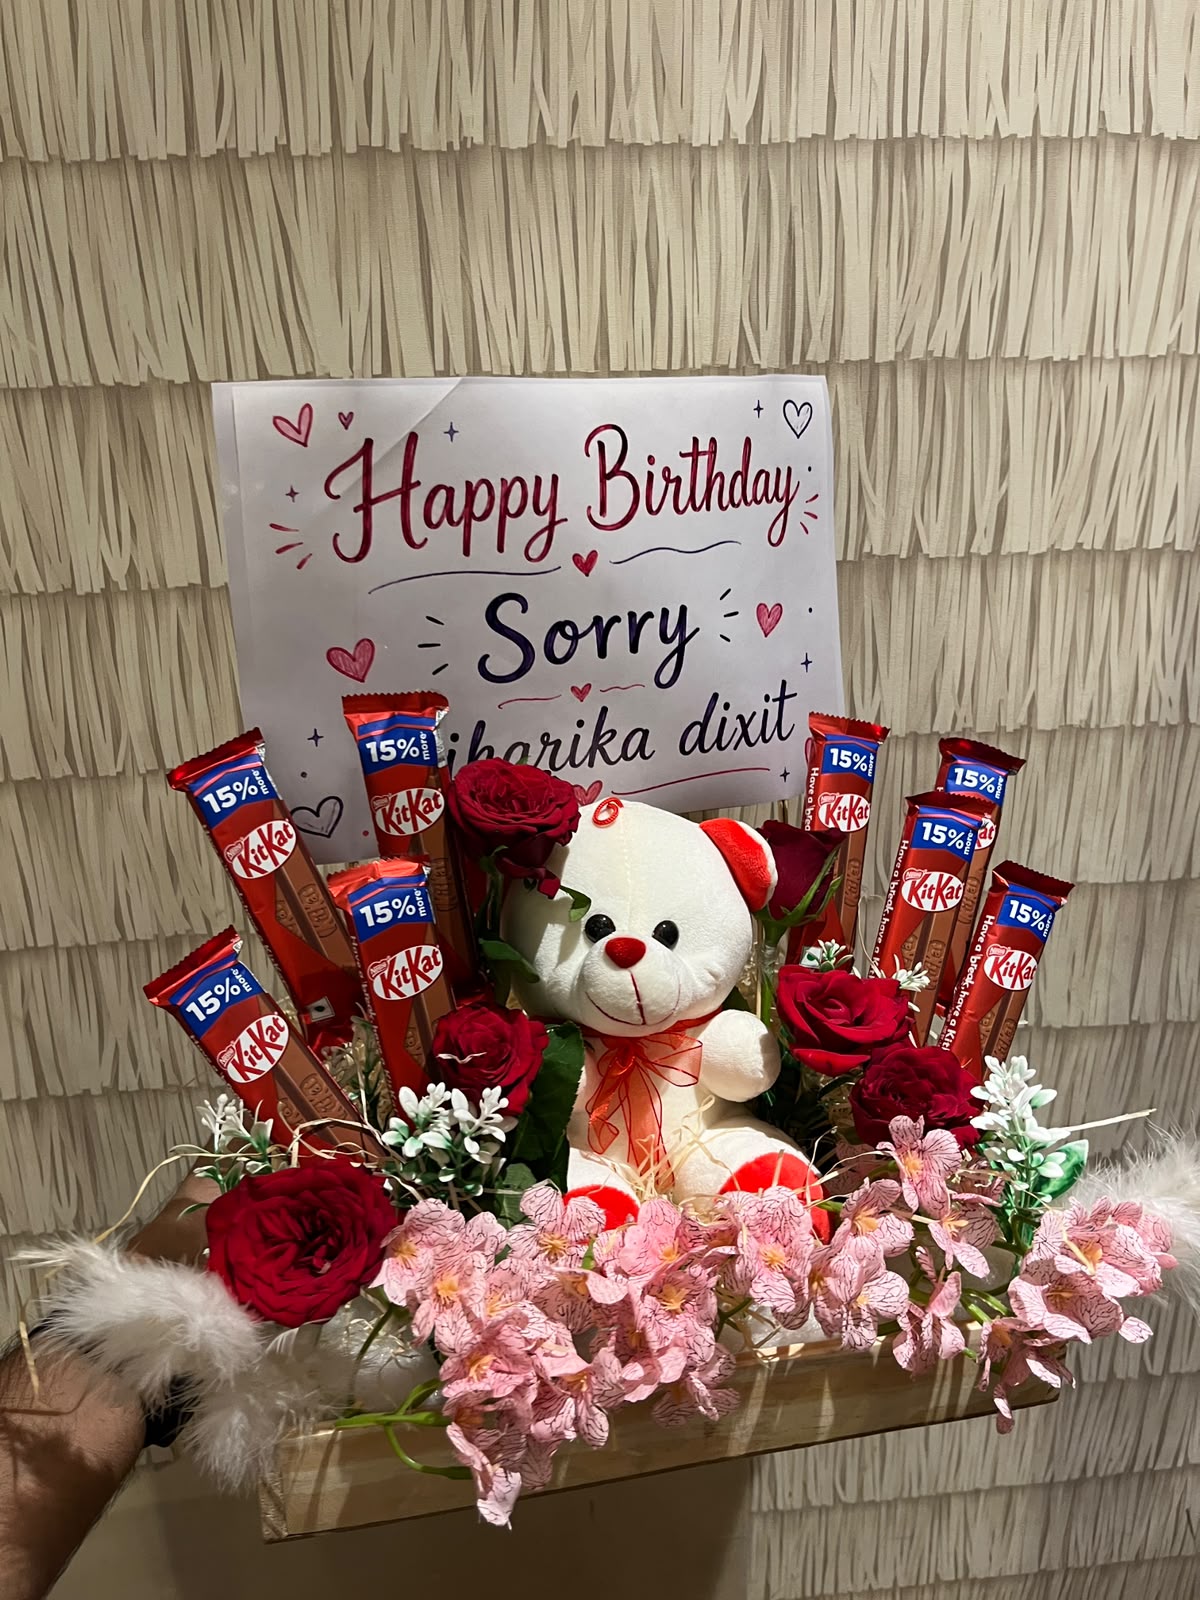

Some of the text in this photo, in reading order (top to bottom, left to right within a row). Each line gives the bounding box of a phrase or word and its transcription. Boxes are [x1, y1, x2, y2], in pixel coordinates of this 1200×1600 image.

[324, 424, 800, 563] Happy Birthday
[478, 592, 700, 689] Sorry
[446, 678, 798, 782] iharika dixit
[366, 737, 420, 763] 15%
[829, 747, 868, 772] 15%
[202, 776, 259, 814] 15%
[808, 767, 819, 795] Have
[954, 767, 995, 793] 15%
[381, 788, 442, 835] KitKat
[825, 795, 869, 831] KitKat
[237, 822, 294, 878] KitKat
[922, 821, 965, 849] 15%
[895, 840, 909, 869] Have
[907, 873, 961, 910] KitKat
[359, 894, 416, 928] 15%
[978, 914, 995, 943] Have
[1009, 899, 1047, 931] 15%
[379, 946, 441, 999] KitKat
[989, 951, 1037, 989] KitKat
[185, 976, 241, 1022] 15%
[953, 991, 970, 1017] have
[230, 1016, 286, 1082] KitKat
[941, 1028, 957, 1051] Kit
